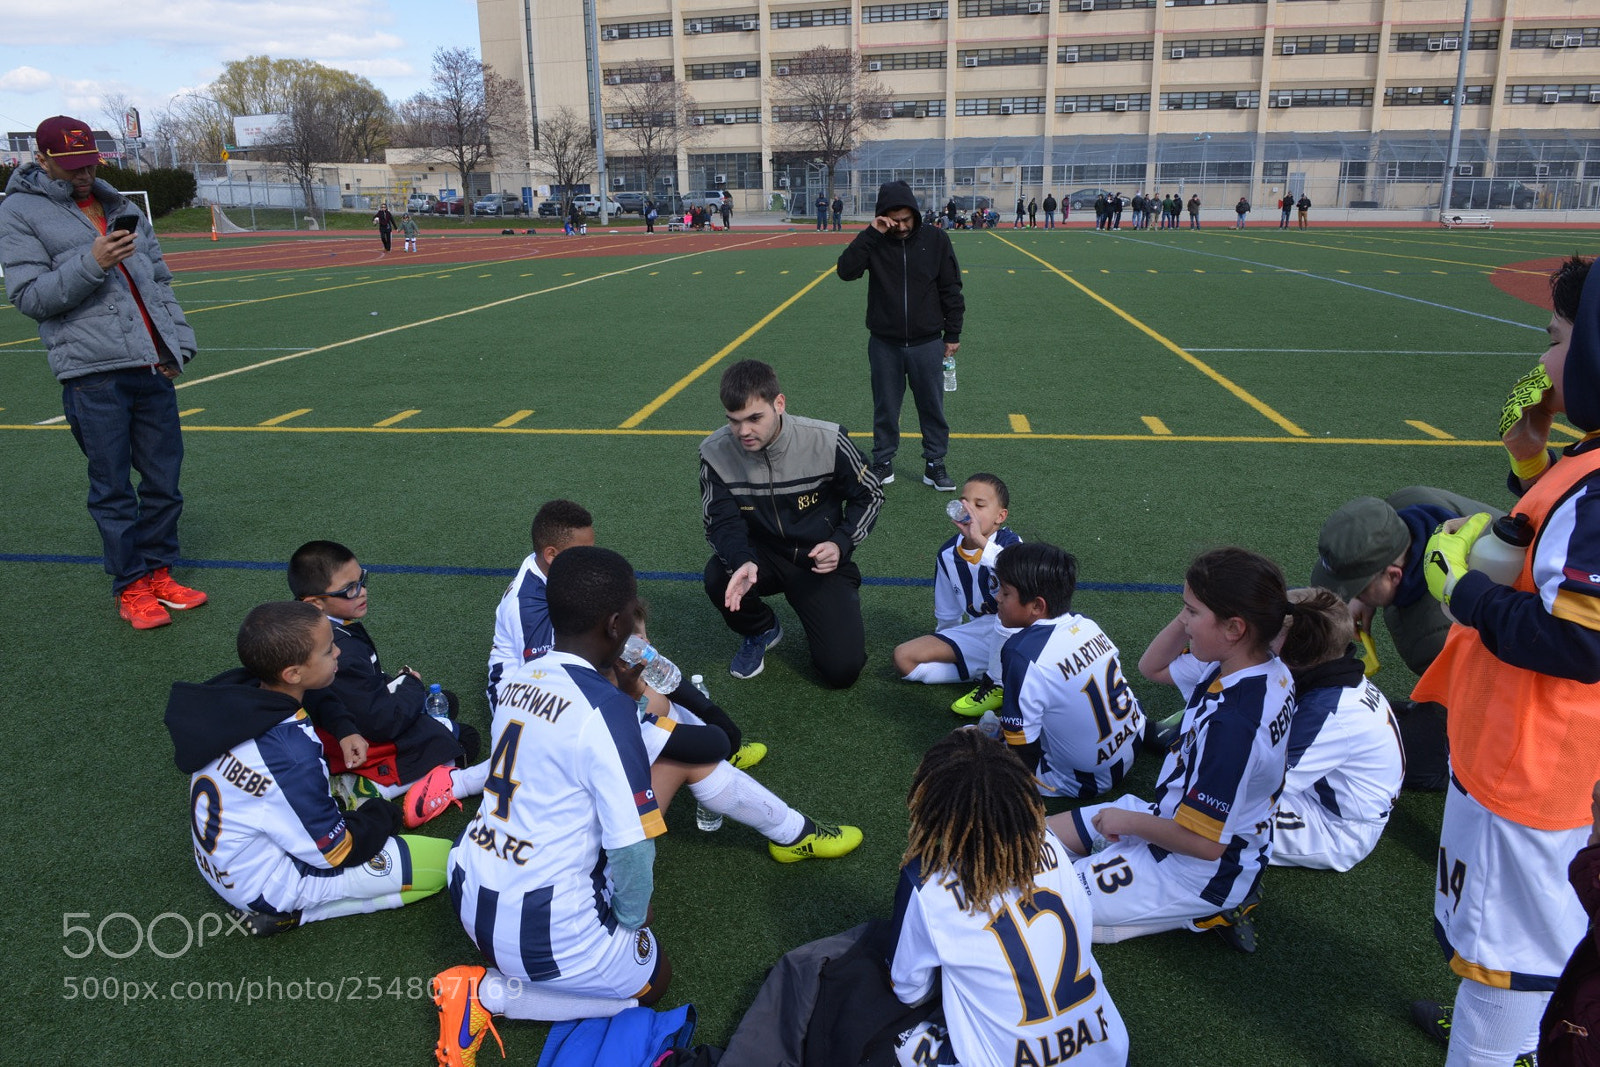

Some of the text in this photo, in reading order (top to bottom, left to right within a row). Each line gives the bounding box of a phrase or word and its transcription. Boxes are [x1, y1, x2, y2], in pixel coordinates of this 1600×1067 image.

[498, 682, 572, 724] OTCHWAY
[1081, 654, 1132, 744] 16
[1096, 724, 1133, 766] ALBA
[483, 719, 525, 823] 4
[502, 832, 534, 867] FC
[1091, 854, 1134, 895] 13
[983, 887, 1097, 1027] 12
[1014, 1017, 1095, 1067] ALBA
